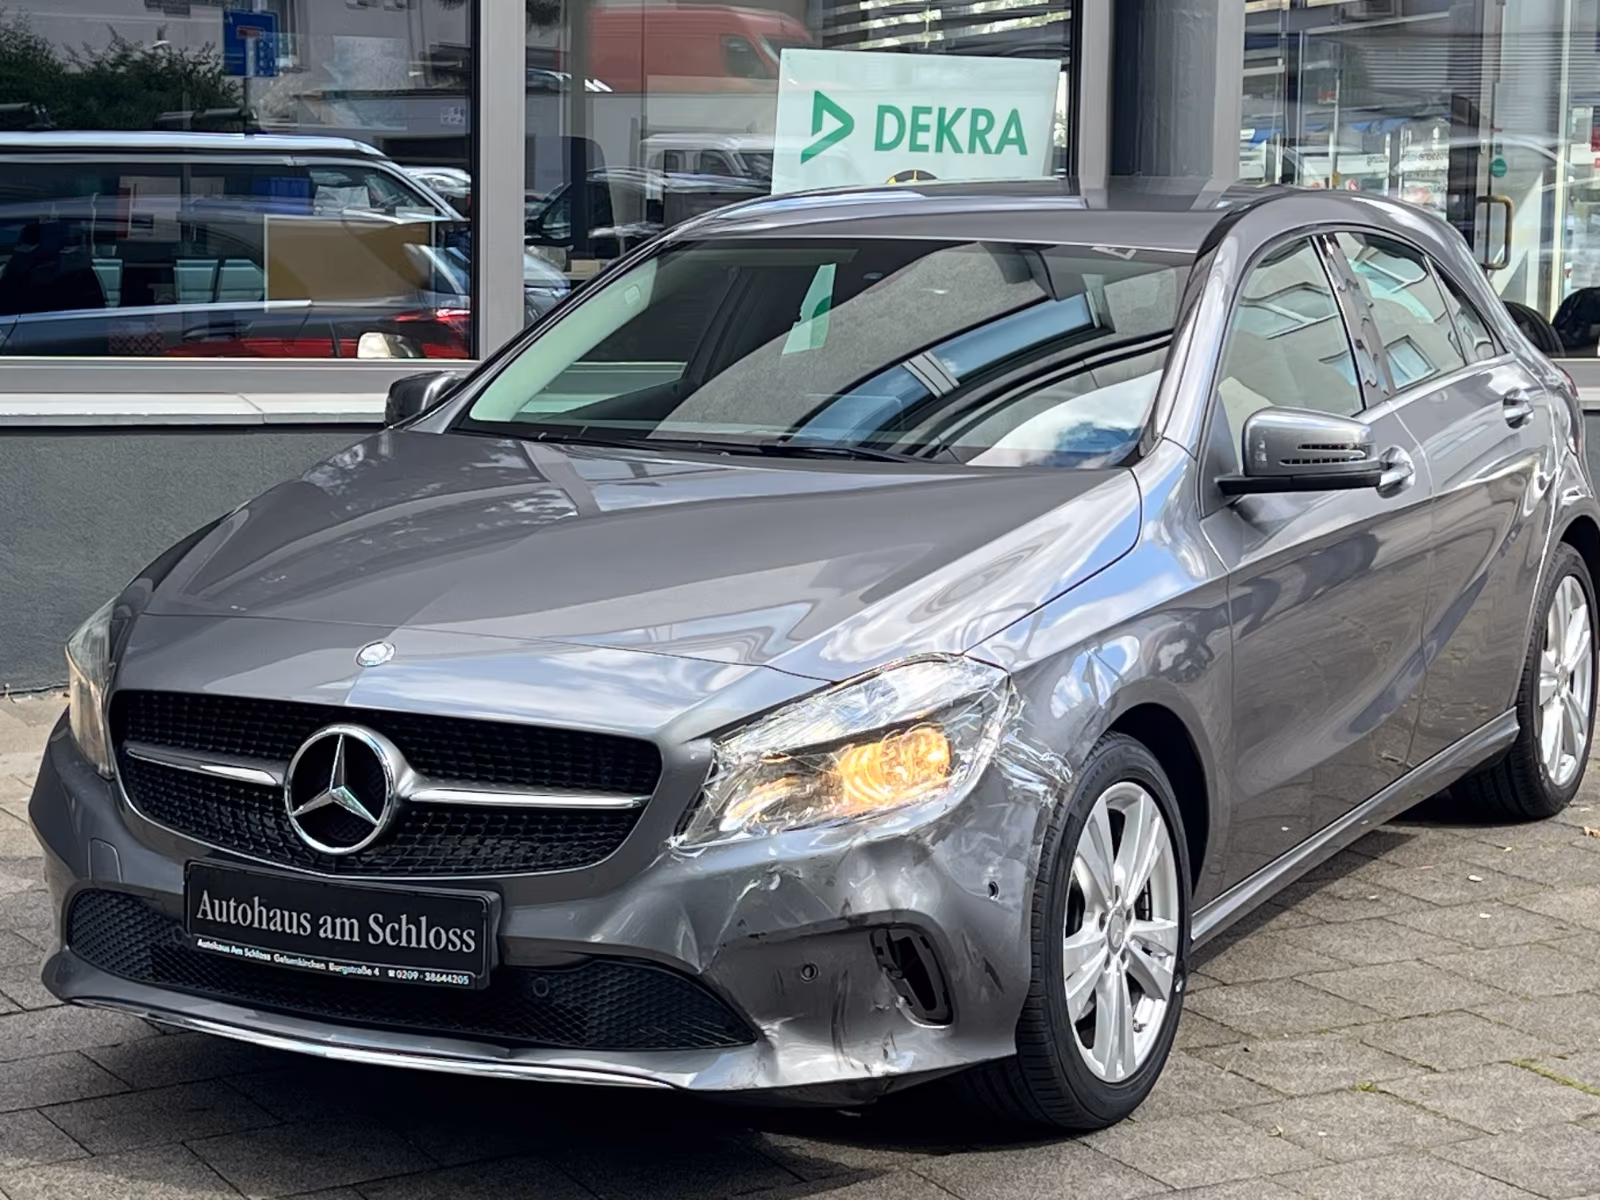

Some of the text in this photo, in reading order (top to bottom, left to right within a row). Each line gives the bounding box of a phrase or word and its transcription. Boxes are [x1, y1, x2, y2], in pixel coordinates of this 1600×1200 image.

[874, 104, 1028, 156] DEKRA
[196, 889, 476, 953] Autohaus am Schloss
[197, 938, 230, 953] Autohaus
[244, 948, 271, 961] Schloss
[273, 953, 326, 970] Gelsenkirchen
[373, 967, 379, 976] 4
[396, 970, 419, 980] 0209
